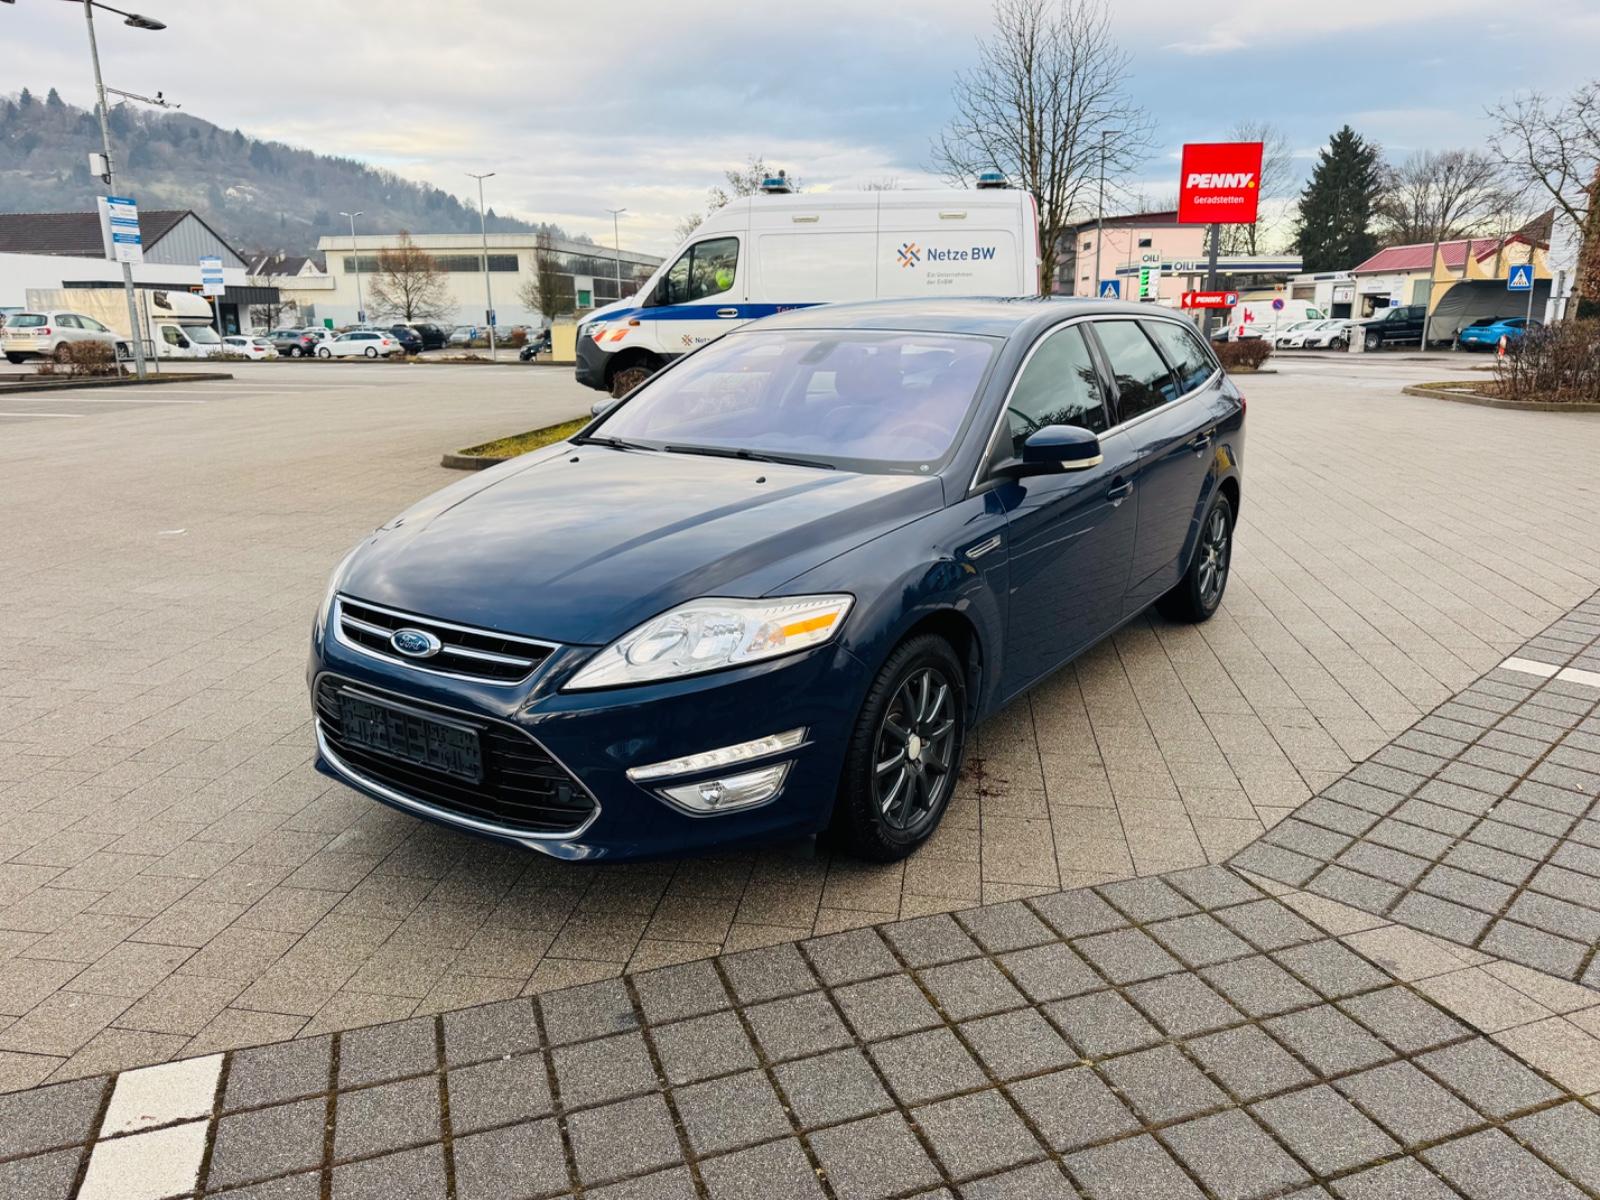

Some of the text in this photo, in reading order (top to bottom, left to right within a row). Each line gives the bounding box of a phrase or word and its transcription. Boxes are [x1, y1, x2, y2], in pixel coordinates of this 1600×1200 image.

[1193, 196, 1244, 204] Geradstetten
[927, 247, 996, 261] Netze BW
[400, 634, 422, 650] Ford
